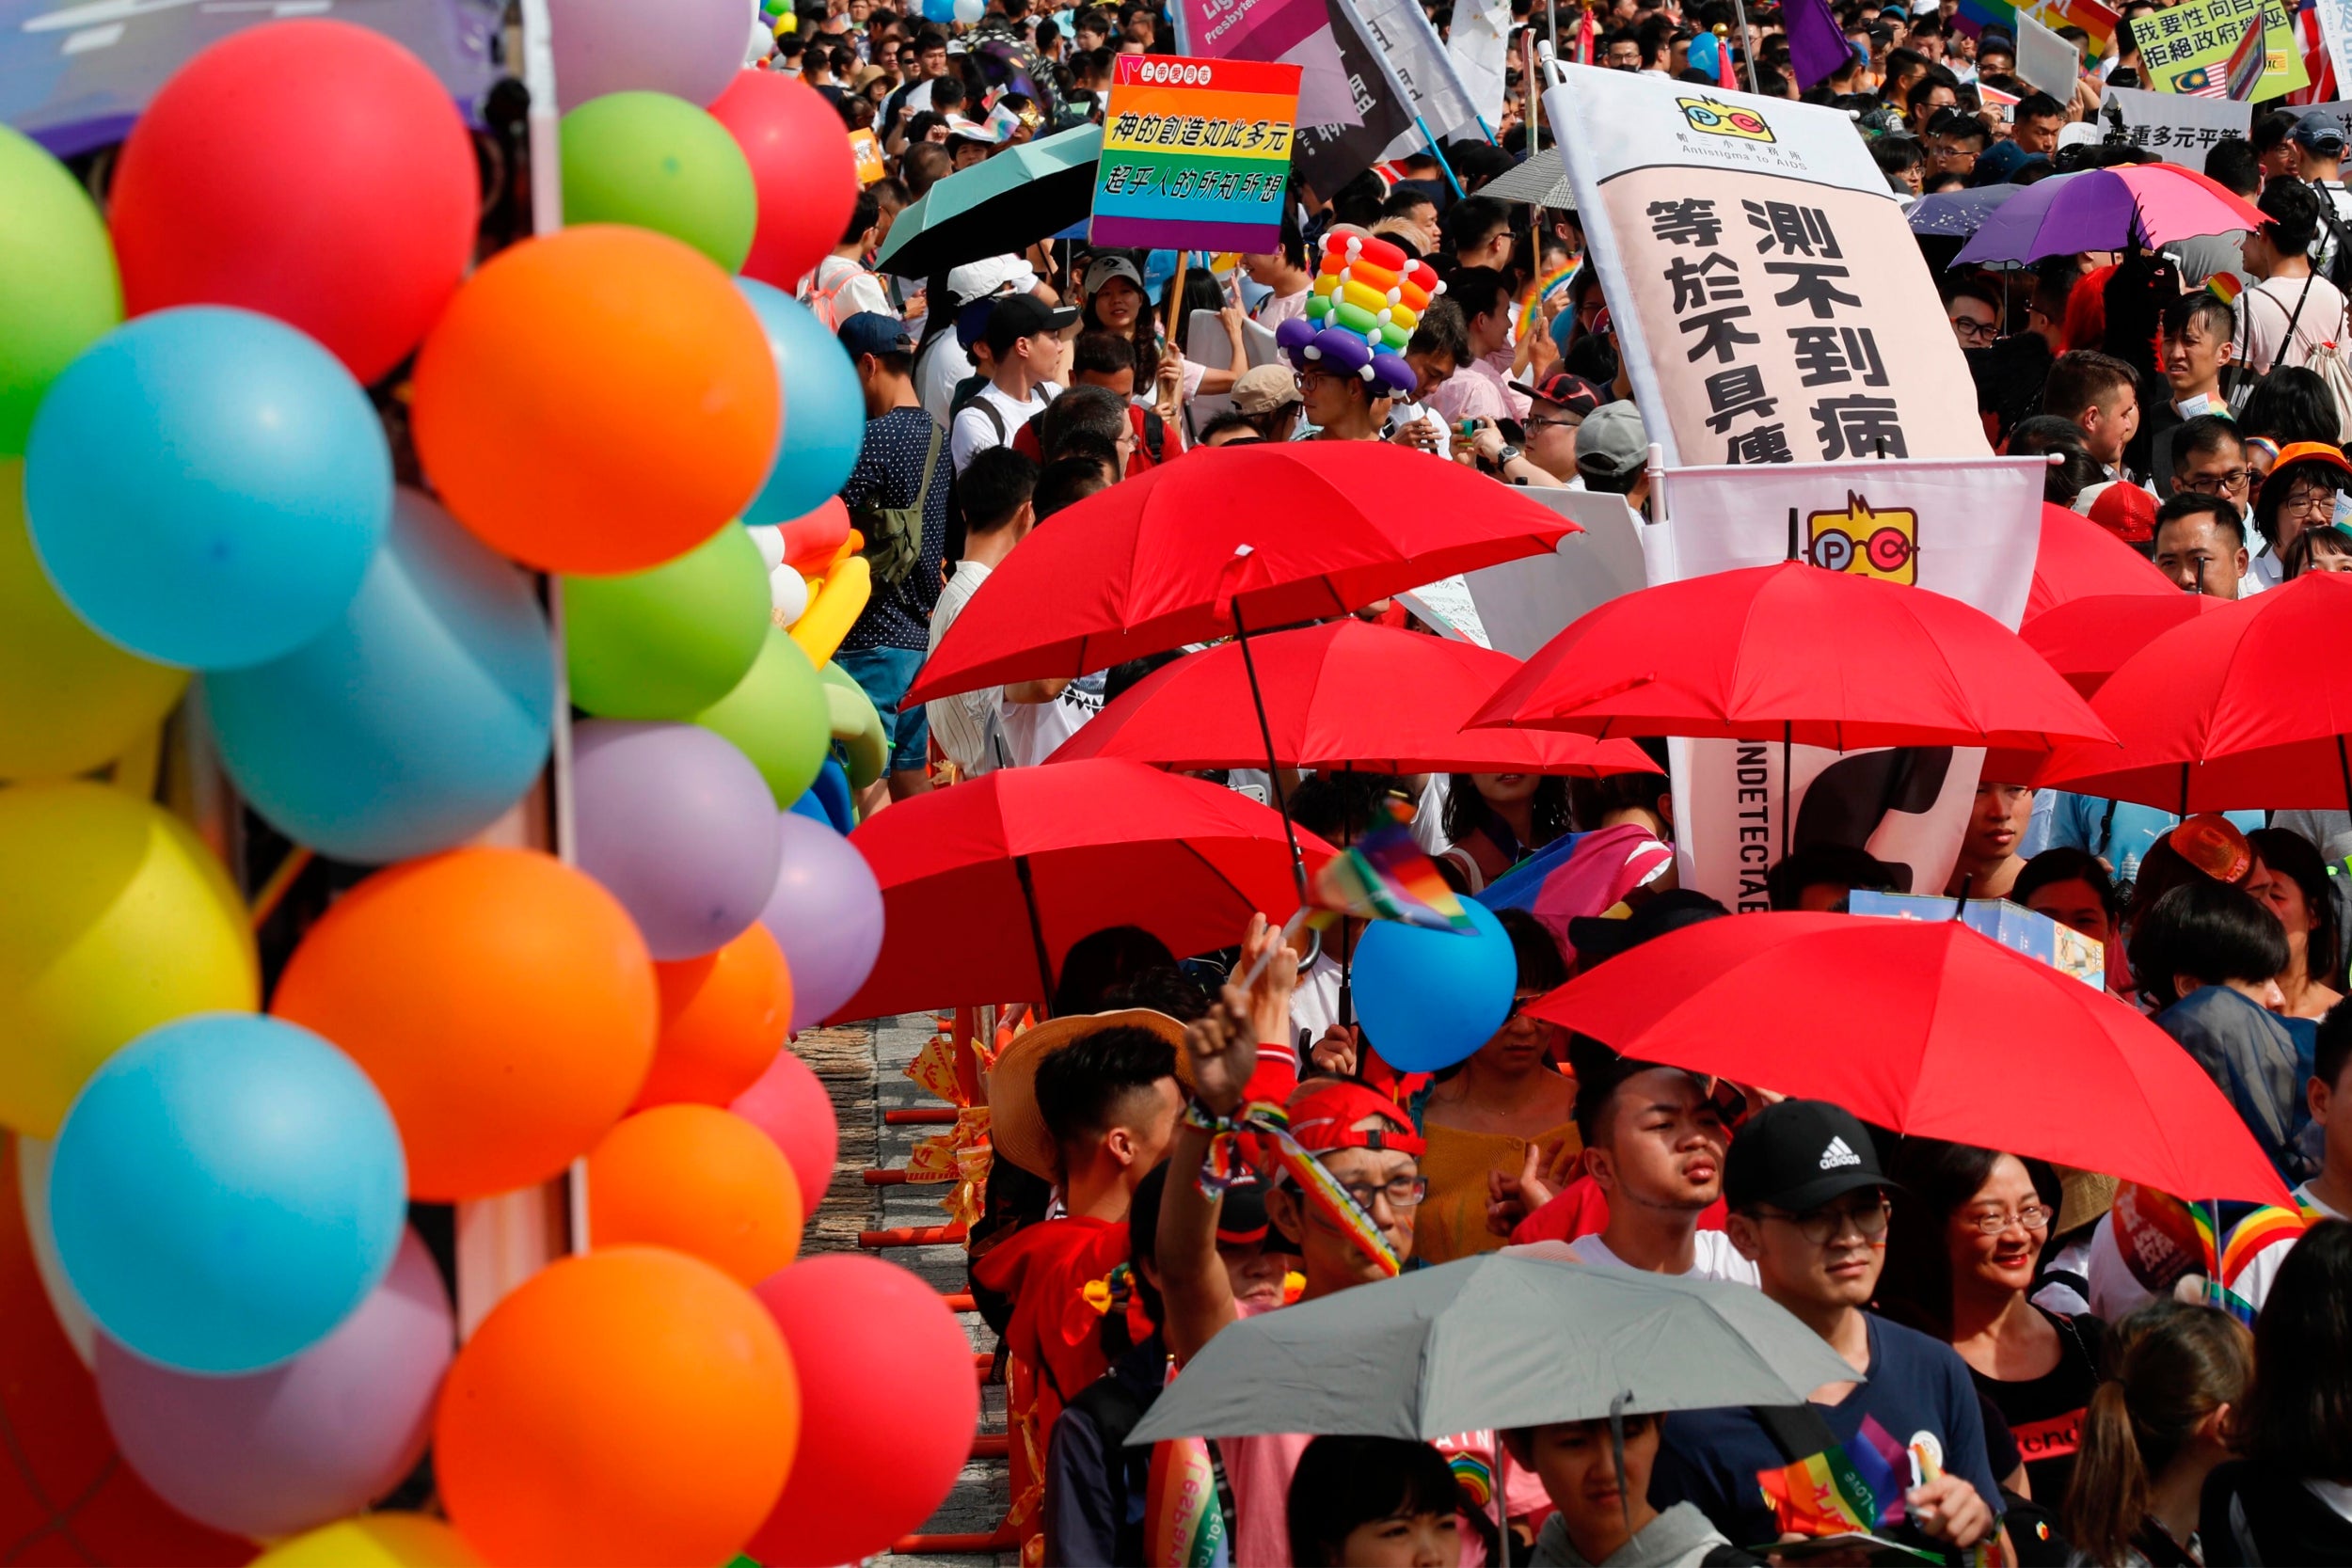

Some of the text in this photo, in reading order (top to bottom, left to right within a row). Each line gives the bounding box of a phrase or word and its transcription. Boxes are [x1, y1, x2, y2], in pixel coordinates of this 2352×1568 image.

[1142, 64, 1210, 84] 上帝愛同志
[1111, 112, 1290, 150] 神的創造如此多元
[1682, 144, 1807, 170] Antistigma to AIDS
[1103, 164, 1284, 203] 超乎人的所知所想
[1740, 198, 1909, 459] 測不到病
[1737, 738, 1769, 914] NDETECTAB
[1820, 1154, 1861, 1169] adidas
